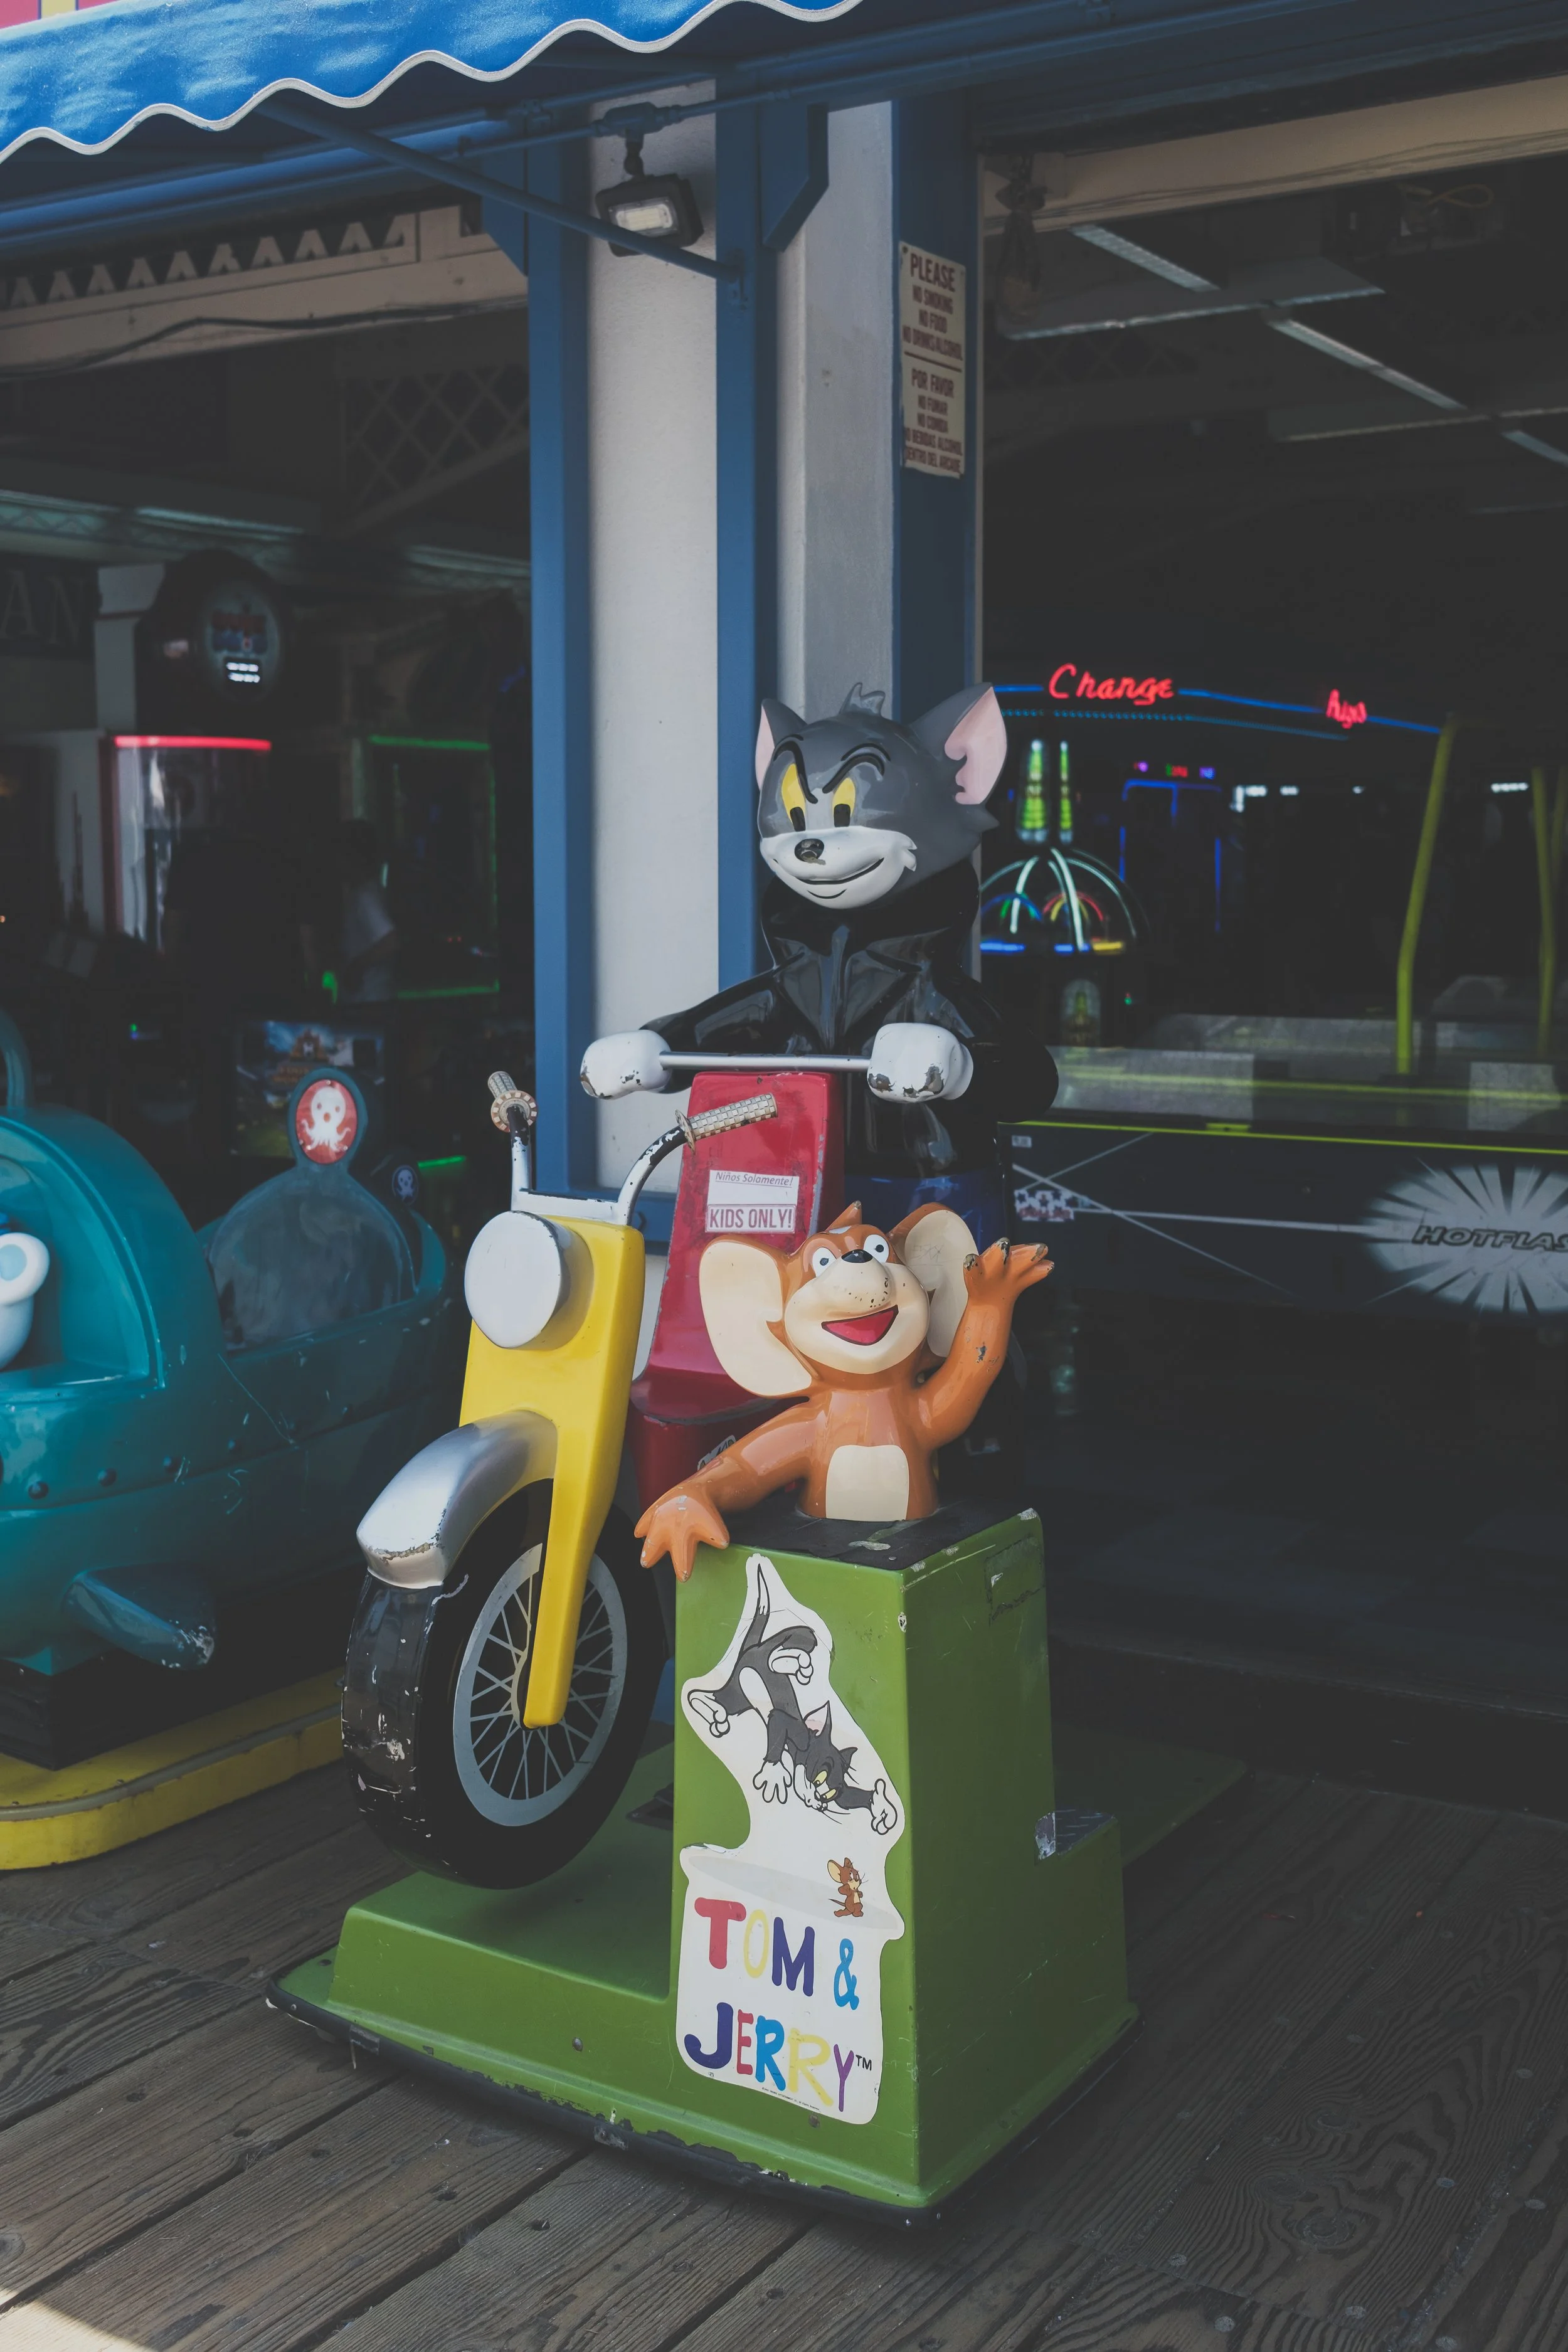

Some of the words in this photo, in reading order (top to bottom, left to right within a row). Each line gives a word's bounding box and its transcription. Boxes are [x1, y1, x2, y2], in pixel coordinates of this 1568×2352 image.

[910, 253, 955, 292] PLEASE
[912, 284, 922, 304] NO
[924, 288, 953, 315] SMOKING
[918, 309, 928, 327] NO
[930, 312, 948, 334] FOOD
[911, 368, 928, 390] POR
[930, 373, 955, 399] FAVOR
[1048, 662, 1174, 706] Change
[715, 1172, 741, 1182] Niños
[742, 1173, 793, 1187] Solamente!
[709, 1208, 744, 1229] KIDS
[748, 1208, 793, 1229] ONLY!
[694, 1897, 815, 1997] TOM
[833, 1938, 860, 2010] &
